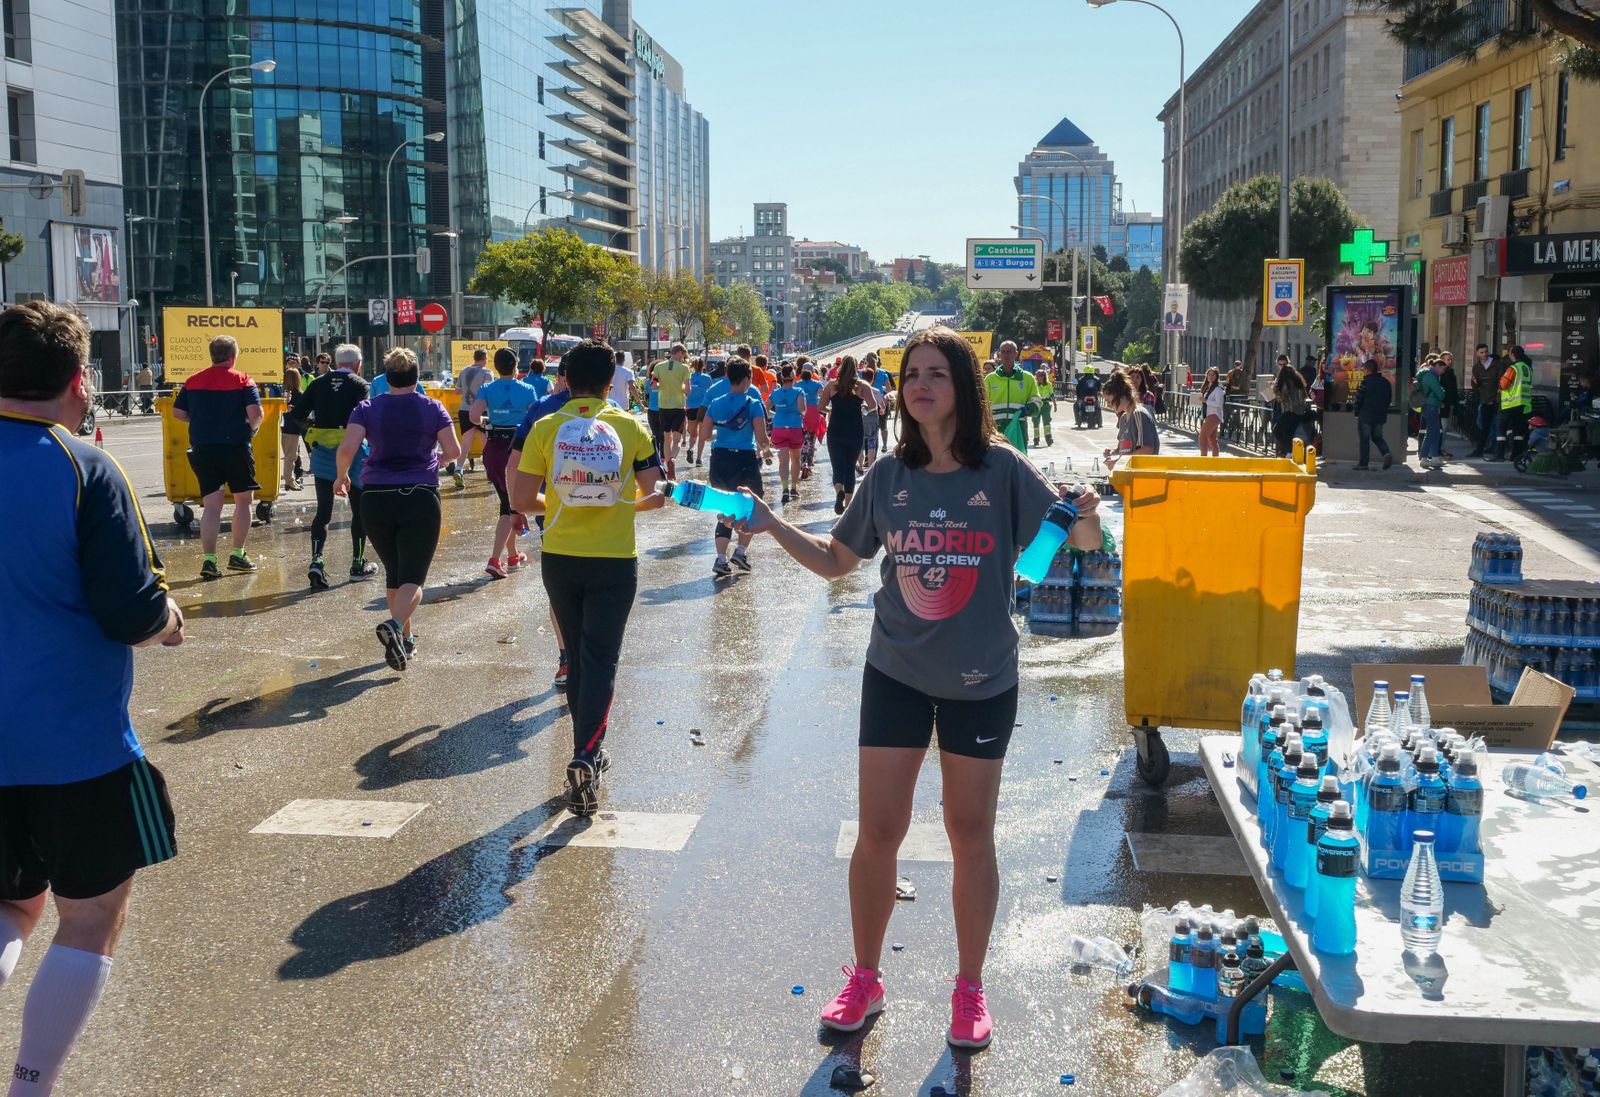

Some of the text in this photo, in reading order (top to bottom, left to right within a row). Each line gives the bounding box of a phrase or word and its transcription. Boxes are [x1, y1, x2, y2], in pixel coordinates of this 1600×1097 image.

[988, 246, 1034, 254] Castellana
[1534, 240, 1557, 264] LA
[1006, 259, 1034, 267] Burgos
[1434, 260, 1467, 283] CARTUCHOS
[1391, 270, 1418, 287] FARMACIA
[1566, 289, 1574, 297] LA
[187, 315, 259, 328] RECICLA
[169, 336, 202, 344] CUANDO
[170, 345, 202, 353] RECICLO
[250, 346, 277, 354] acierto
[462, 343, 497, 351] RECICLA
[558, 441, 585, 452] Rock
[929, 508, 947, 520] edp
[908, 520, 936, 528] Rock
[944, 520, 969, 529] Roll
[887, 529, 996, 554] MADRID
[895, 555, 981, 566] RACE CREW
[923, 566, 946, 583] 42
[1519, 635, 1568, 644] POWERADE
[1505, 720, 1534, 728] vending
[1318, 846, 1355, 857] OWERADE
[1374, 858, 1478, 873] POWADE
